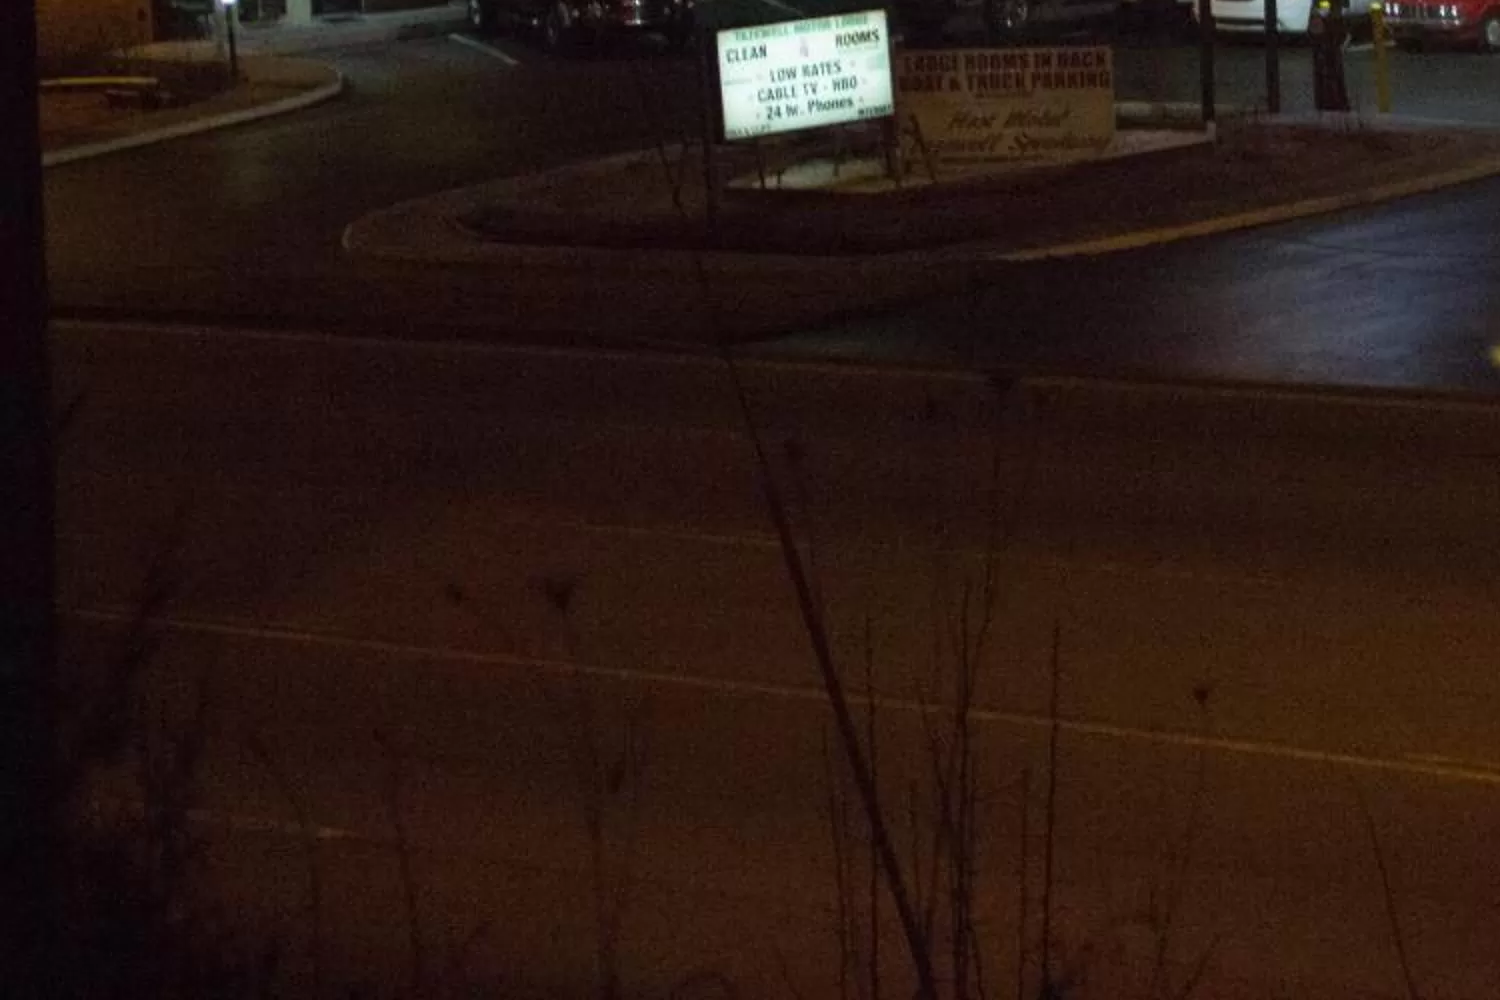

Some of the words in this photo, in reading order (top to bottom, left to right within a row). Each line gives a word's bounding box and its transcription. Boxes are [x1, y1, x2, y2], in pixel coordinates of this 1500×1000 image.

[726, 44, 767, 63] CLEAN
[835, 29, 880, 47] ROOMS
[769, 66, 797, 83] LOW
[802, 60, 842, 77] RATES
[964, 53, 1029, 70] ROOMS
[757, 86, 796, 102] CABLE
[803, 83, 817, 98] TV
[833, 75, 857, 92] HBO
[967, 72, 1025, 90] TRUCK
[1031, 71, 1110, 88] PARKING
[767, 103, 781, 120] 24
[807, 96, 854, 113] Phones
